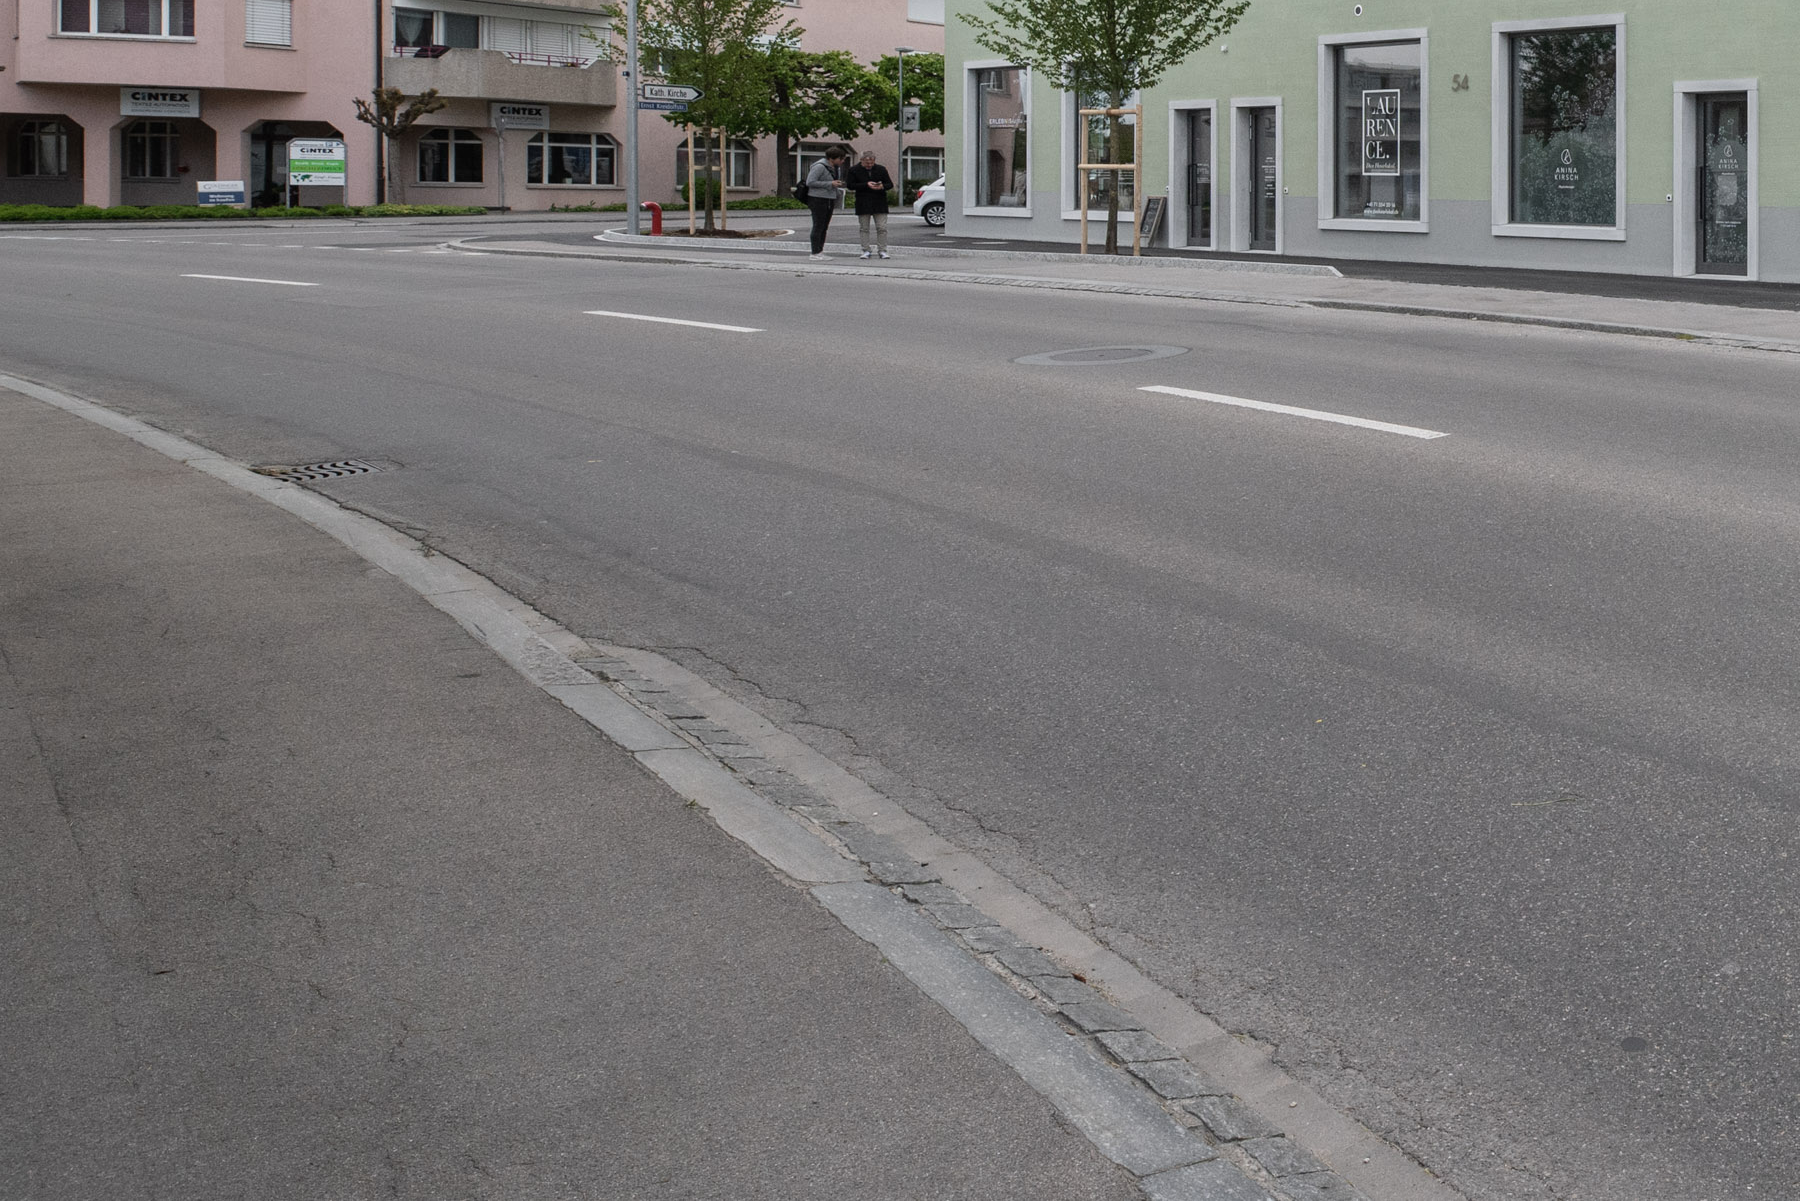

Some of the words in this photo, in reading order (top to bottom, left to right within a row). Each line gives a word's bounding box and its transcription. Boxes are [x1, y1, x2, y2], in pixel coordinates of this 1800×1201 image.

[1451, 73, 1469, 92] 54
[650, 87, 666, 96] Kath.
[667, 88, 688, 98] Kirche
[1365, 96, 1397, 115] LAU
[1365, 118, 1396, 137] REN
[1365, 140, 1391, 160] CE.
